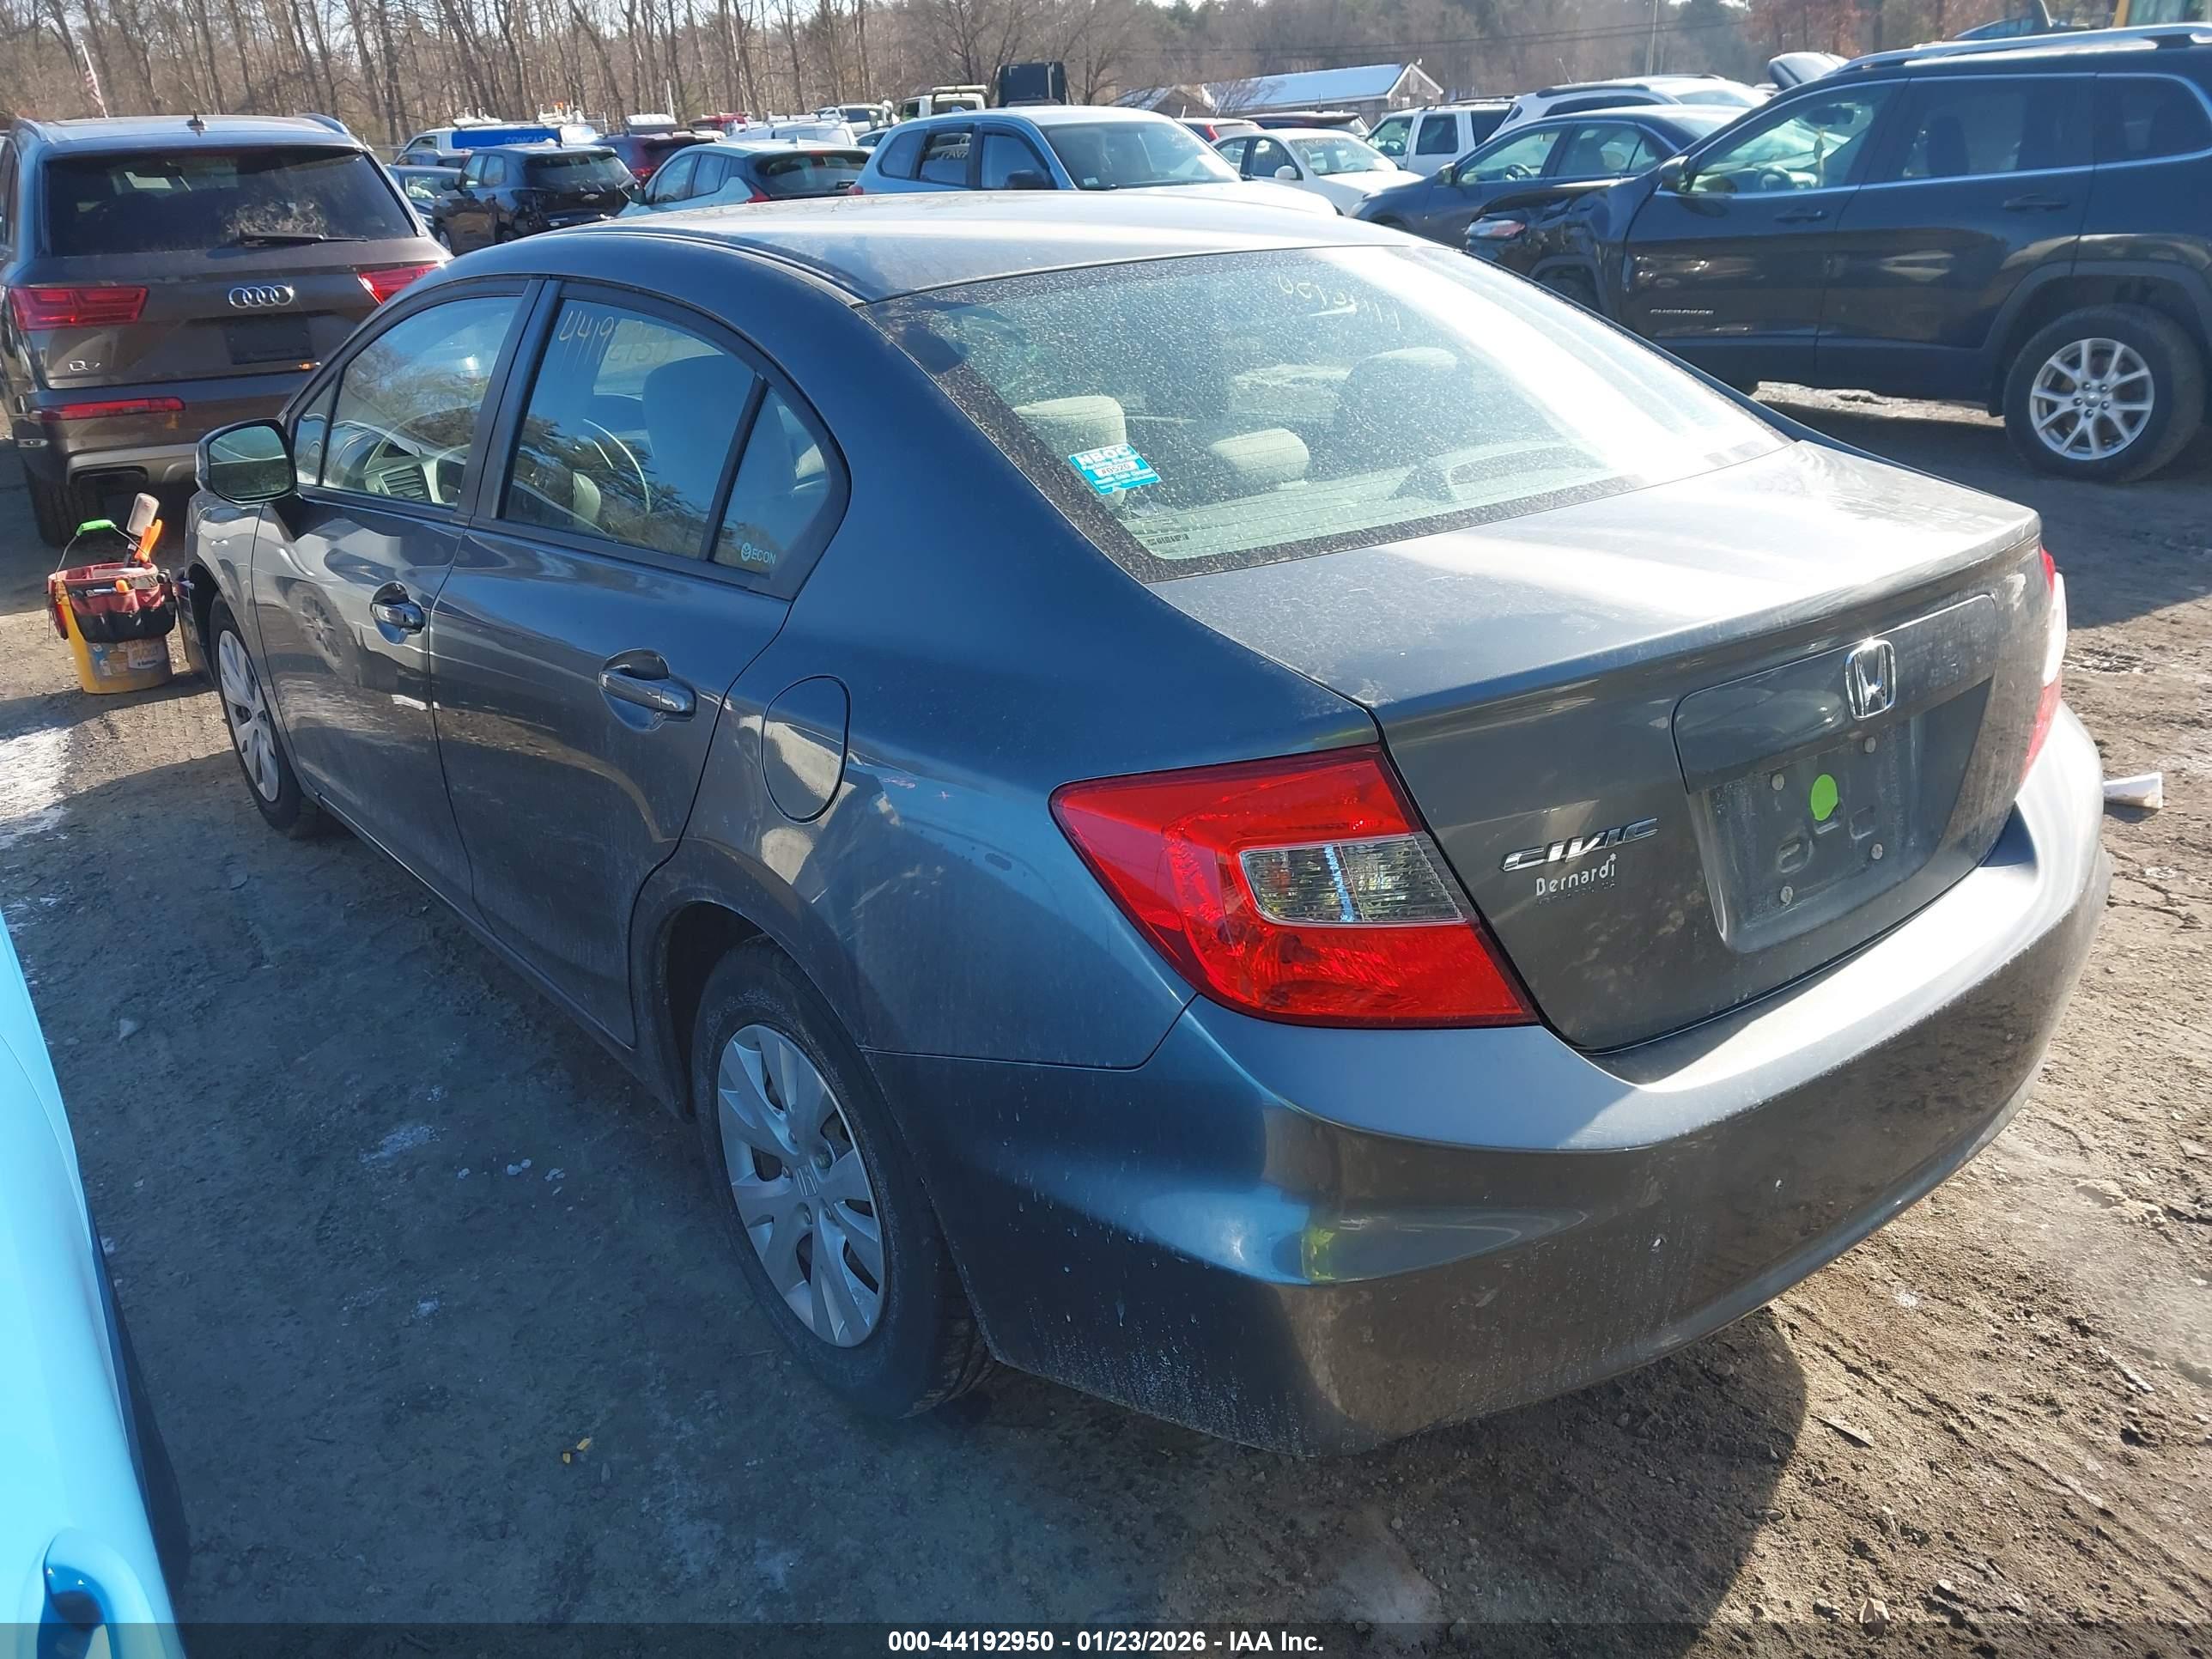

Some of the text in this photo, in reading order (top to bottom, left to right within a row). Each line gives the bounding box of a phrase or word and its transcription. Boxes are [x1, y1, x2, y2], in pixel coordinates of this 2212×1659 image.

[750, 548, 776, 564] ECON
[1501, 817, 1659, 872] CIVIC
[1535, 853, 1617, 896] Bernardi
